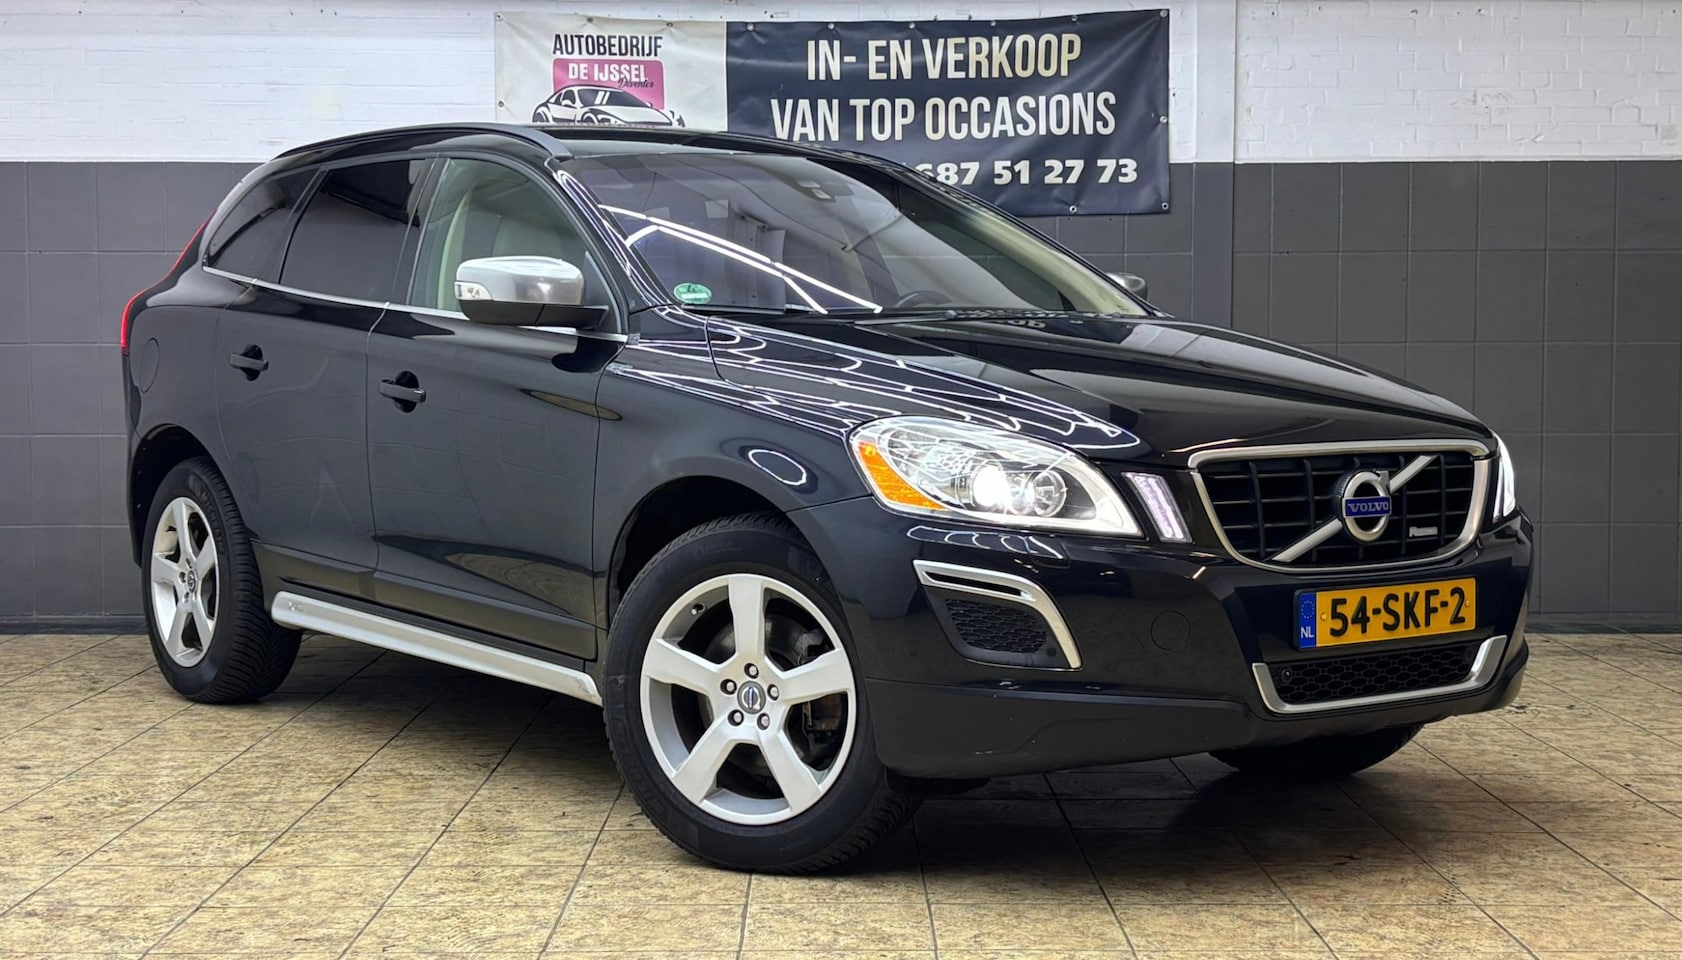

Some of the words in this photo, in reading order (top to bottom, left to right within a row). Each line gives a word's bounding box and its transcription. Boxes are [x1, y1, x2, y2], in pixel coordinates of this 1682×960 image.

[552, 34, 663, 57] AUTOBEDRIJF
[807, 40, 856, 81] IN-
[868, 39, 912, 80] EN
[922, 33, 1081, 79] VERKOOP
[568, 62, 588, 80] DE
[593, 63, 649, 82] IJSSEL
[771, 98, 840, 142] VAN
[850, 97, 915, 142] TOP
[925, 91, 1117, 141] OCCASIONS
[993, 159, 1030, 185] 51
[1044, 159, 1085, 184] 27
[1097, 158, 1138, 183] 73
[1347, 501, 1389, 513] VOLVO
[1329, 586, 1466, 637] 54-SKF-2
[1300, 626, 1315, 639] NL
